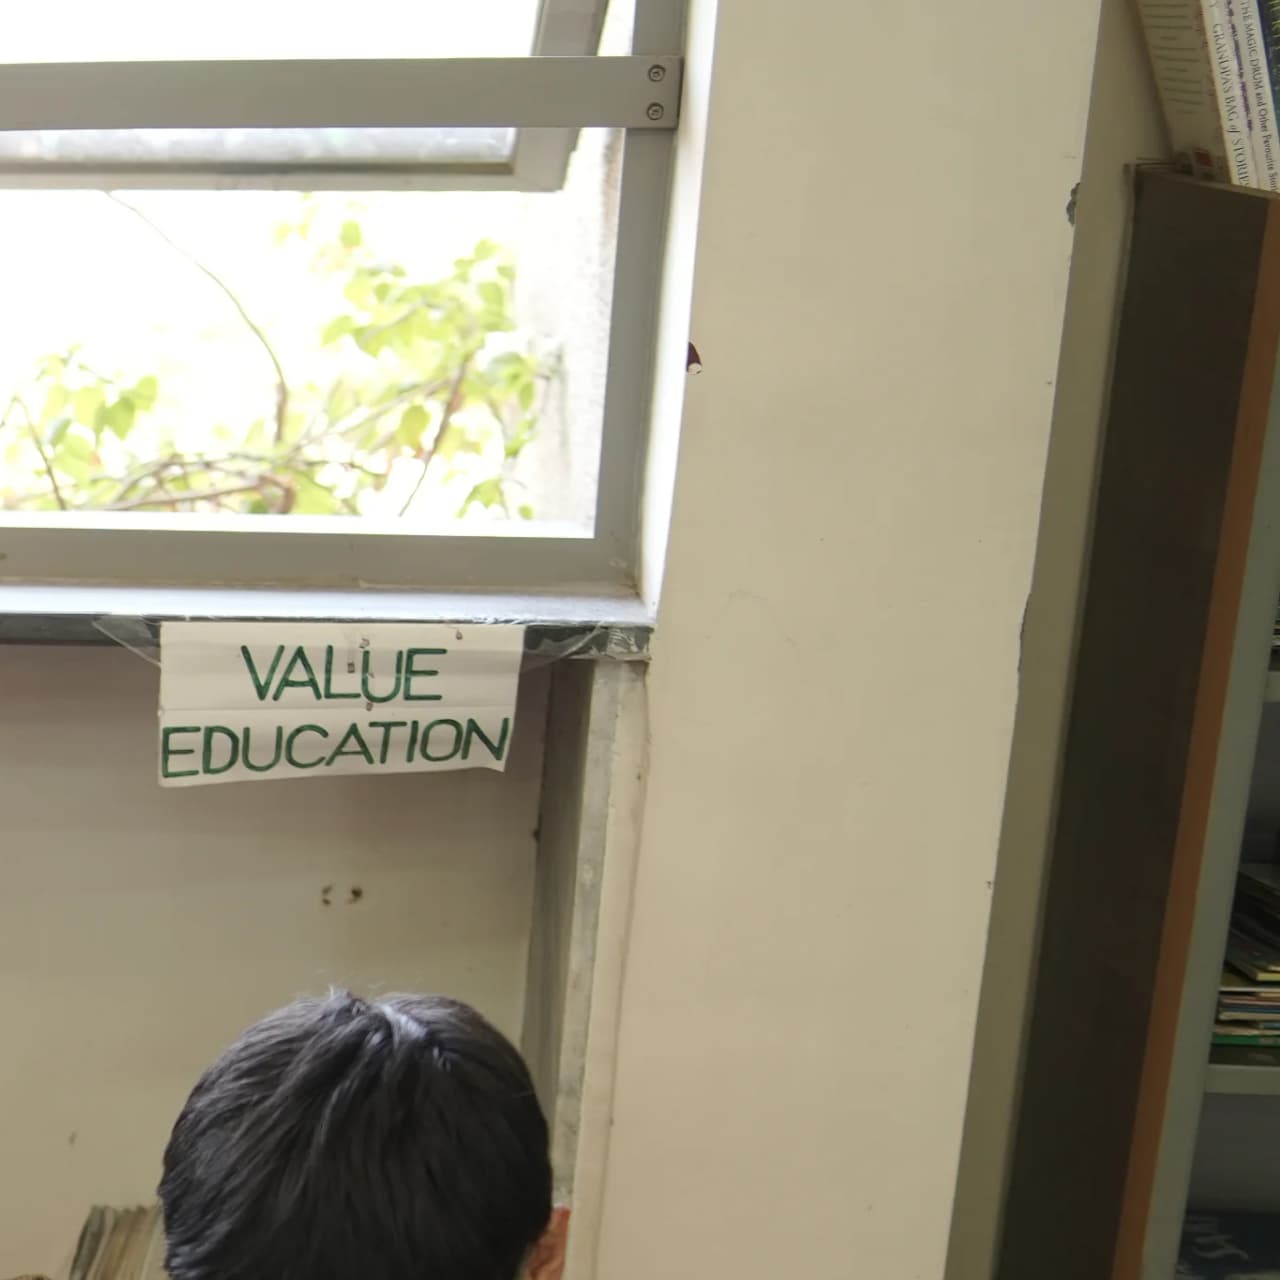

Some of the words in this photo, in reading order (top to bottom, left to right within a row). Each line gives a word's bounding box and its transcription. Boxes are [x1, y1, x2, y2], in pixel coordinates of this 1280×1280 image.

[1244, 23, 1257, 57] MAGIC
[1249, 59, 1264, 90] DRUM
[1224, 95, 1239, 121] BAG
[1258, 108, 1271, 132] Other
[240, 643, 448, 703] VALUE
[162, 717, 510, 779] EDUCATION
